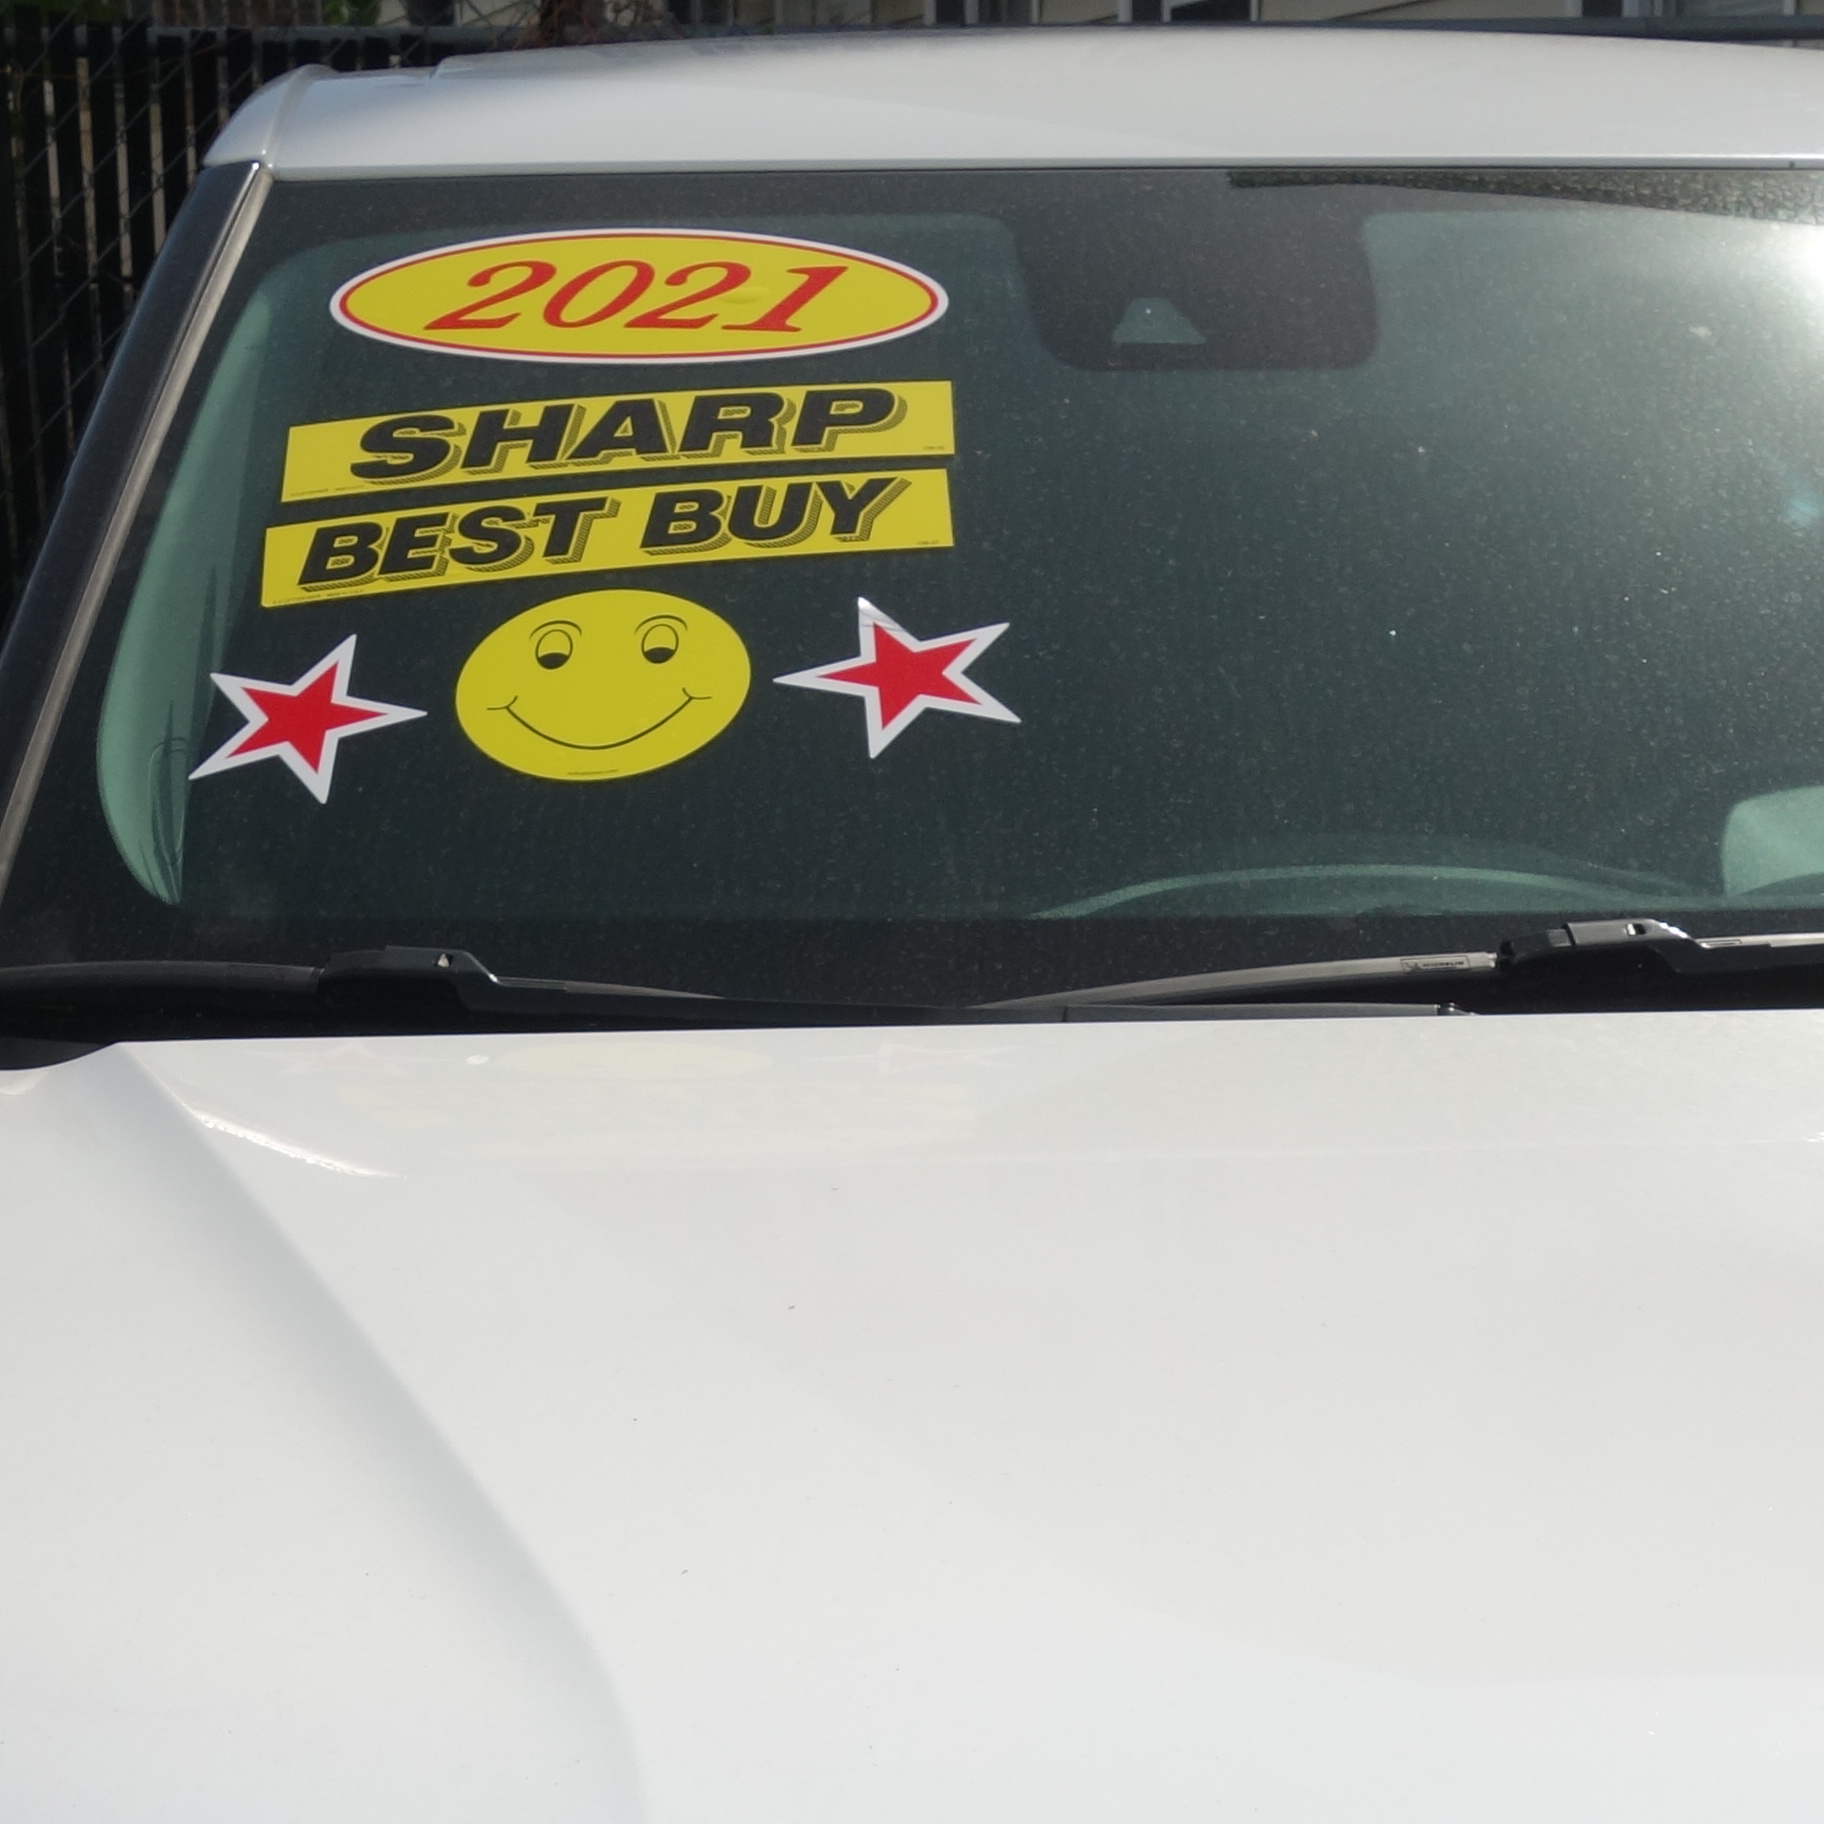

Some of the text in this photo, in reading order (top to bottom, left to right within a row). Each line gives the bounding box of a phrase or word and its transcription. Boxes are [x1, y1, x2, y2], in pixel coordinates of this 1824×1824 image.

[422, 259, 849, 332] 2021
[349, 386, 908, 486] SHARP
[297, 476, 912, 593] BEST BUY
